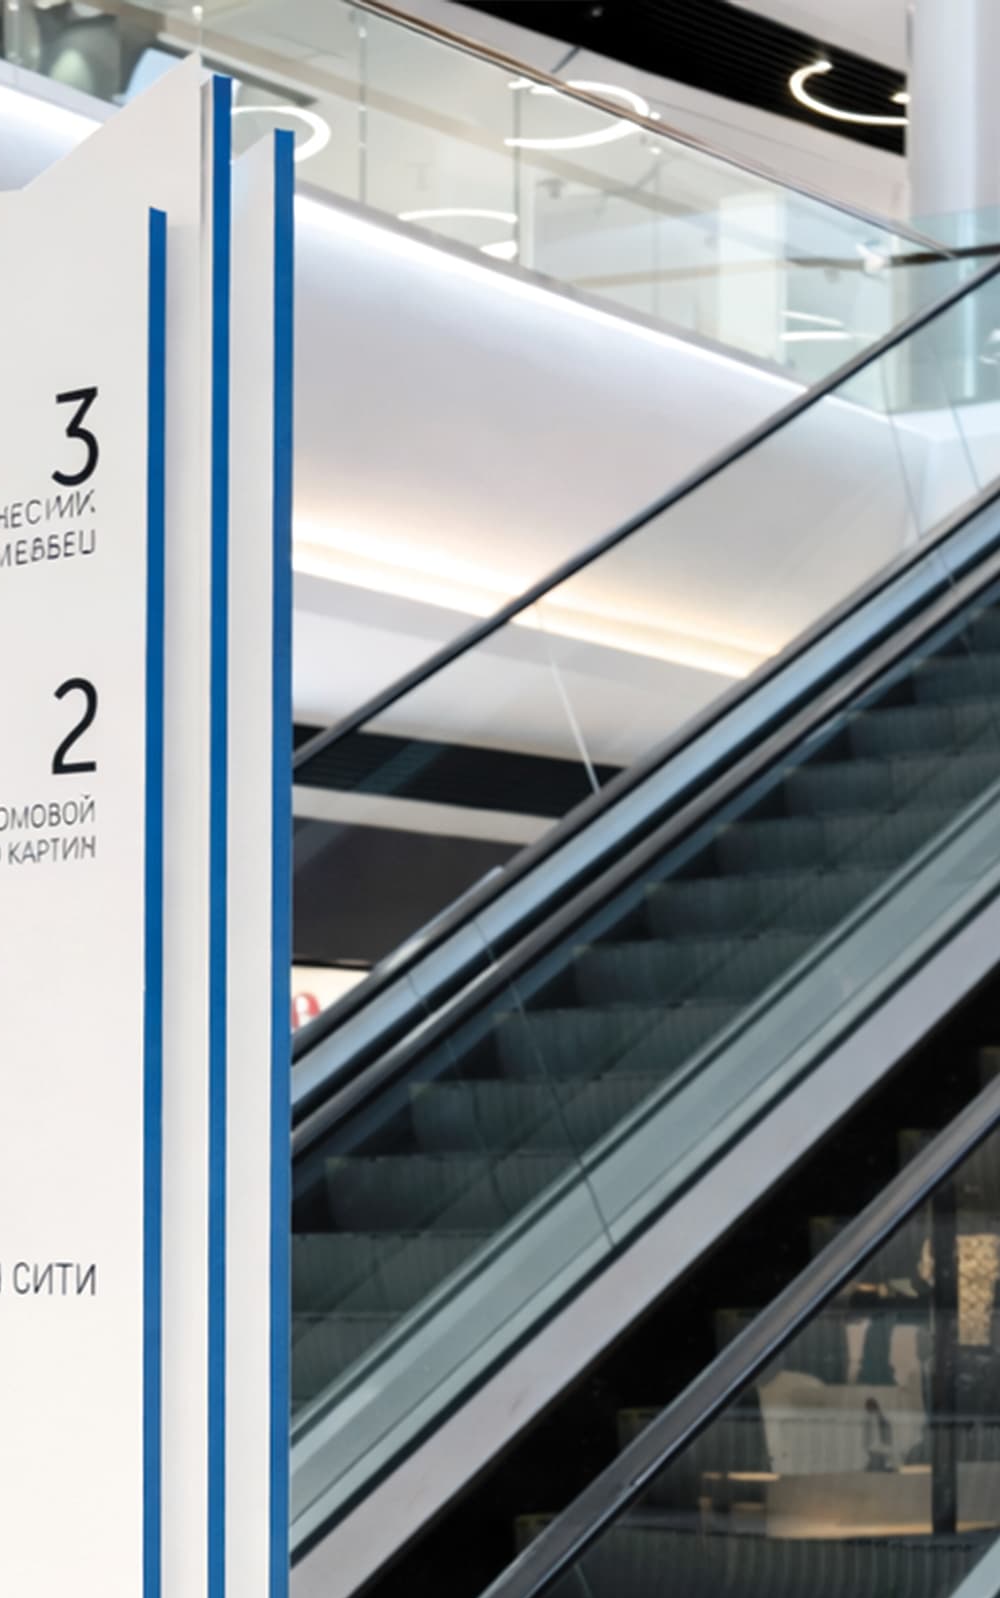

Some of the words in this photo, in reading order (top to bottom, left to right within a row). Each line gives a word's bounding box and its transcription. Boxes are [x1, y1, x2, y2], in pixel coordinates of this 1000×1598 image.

[51, 386, 99, 487] 3
[52, 677, 98, 775] 2
[8, 835, 97, 865] КАРТИН
[12, 1261, 97, 1296] СИТИ
